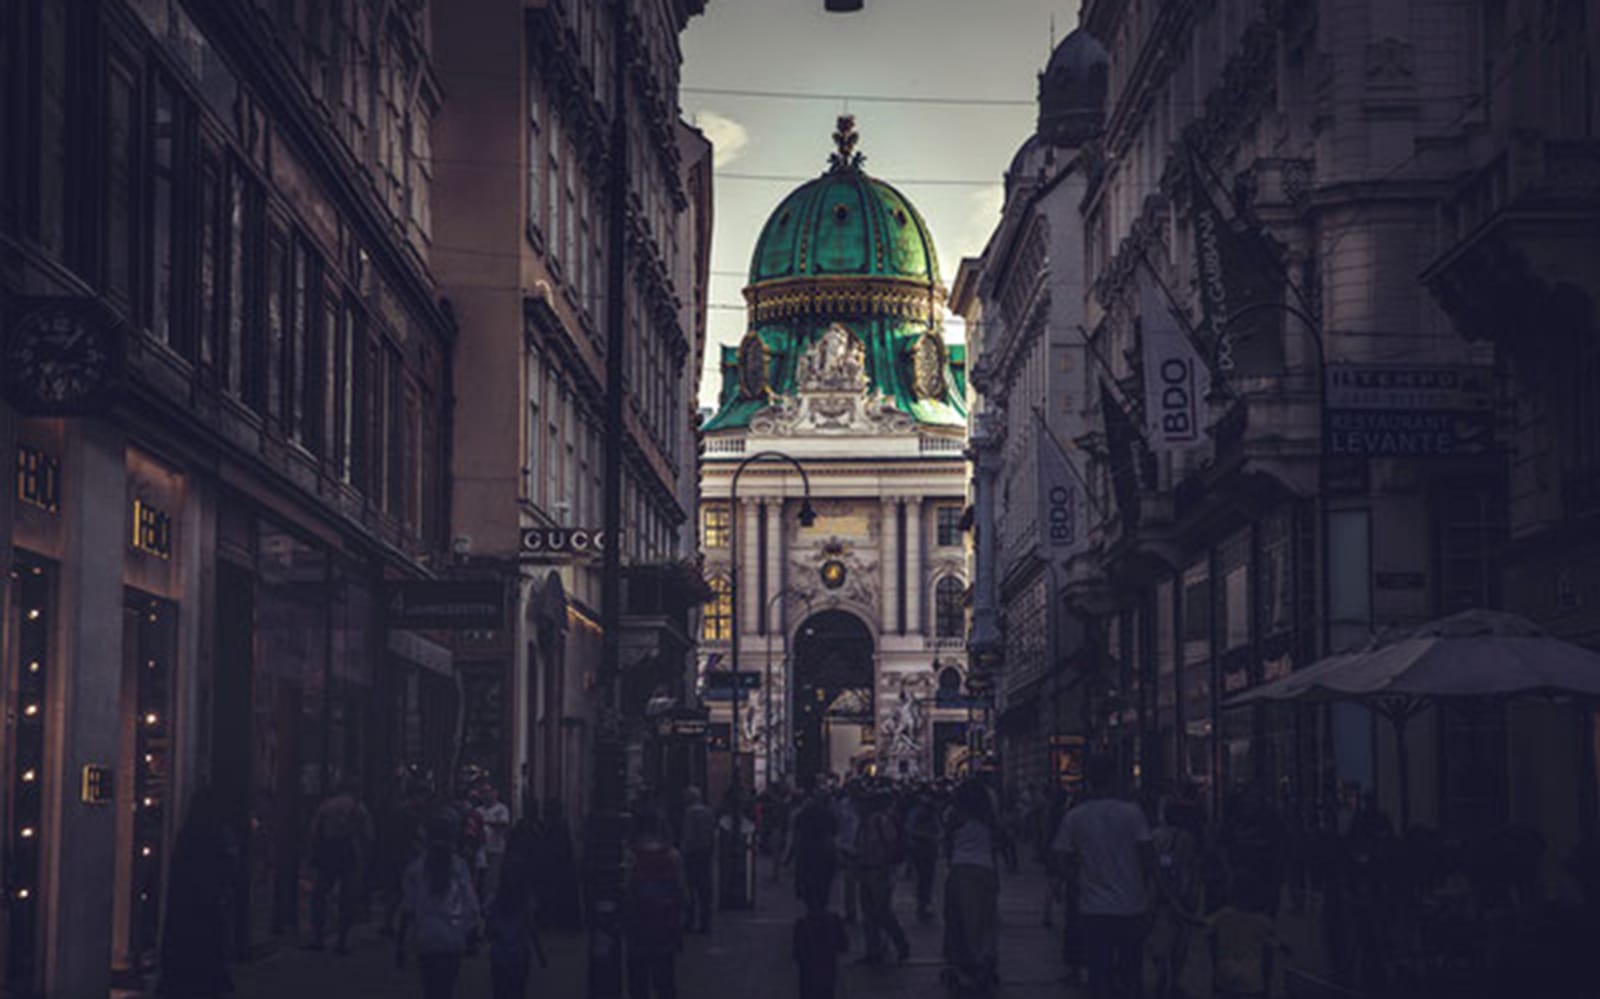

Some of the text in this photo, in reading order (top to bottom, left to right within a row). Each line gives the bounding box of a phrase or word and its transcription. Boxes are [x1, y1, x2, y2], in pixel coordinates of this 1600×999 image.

[1161, 358, 1189, 433] BDO
[1331, 431, 1451, 454] LEVANTE
[1048, 485, 1069, 540] BDO
